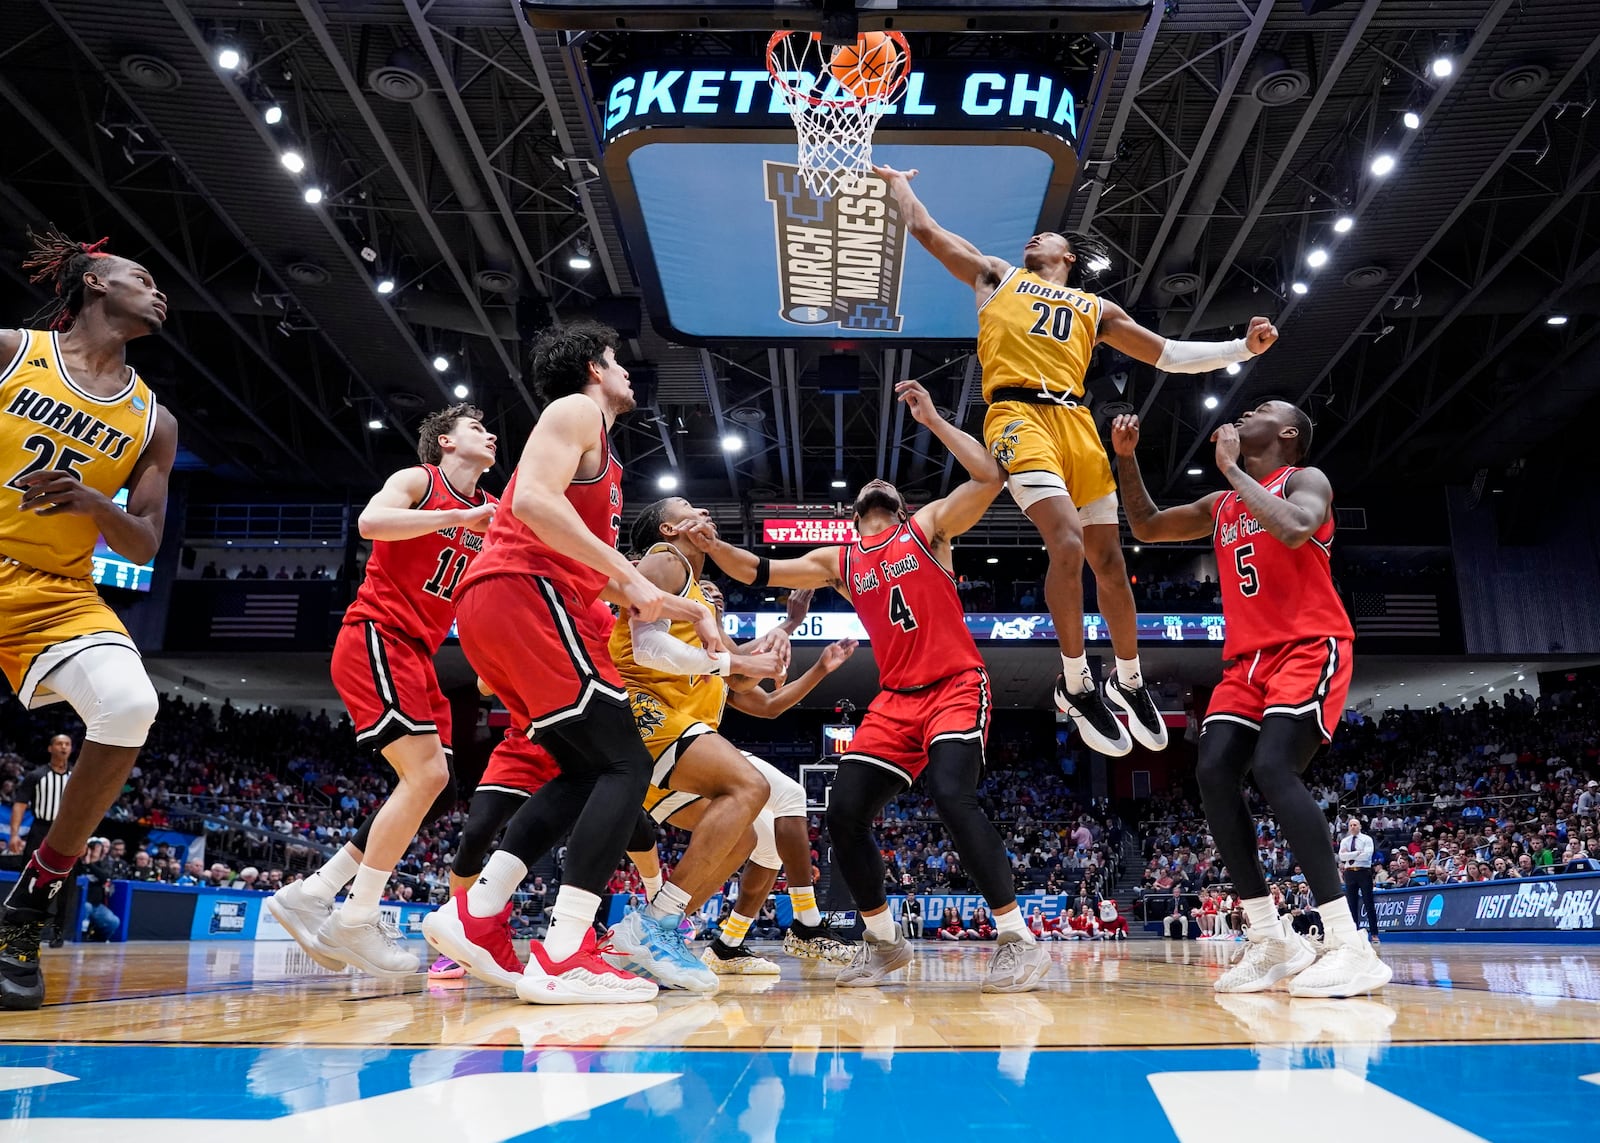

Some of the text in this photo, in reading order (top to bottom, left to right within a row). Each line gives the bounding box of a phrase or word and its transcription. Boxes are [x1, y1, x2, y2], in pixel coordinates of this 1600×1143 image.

[837, 175, 887, 300] MADNESS
[786, 225, 833, 307] MARCH
[1015, 280, 1094, 314] HORNETS
[1028, 301, 1073, 342] 20
[4, 386, 135, 460] HORNETS
[778, 528, 847, 541] FLIGHT
[796, 521, 822, 529] THE
[422, 546, 469, 602] 11
[854, 553, 919, 595] Saint Francis
[1234, 542, 1260, 598] 5
[889, 584, 918, 634] 4
[1166, 625, 1183, 640] 41
[1207, 625, 1224, 640] 31
[1476, 895, 1512, 919] VISIT
